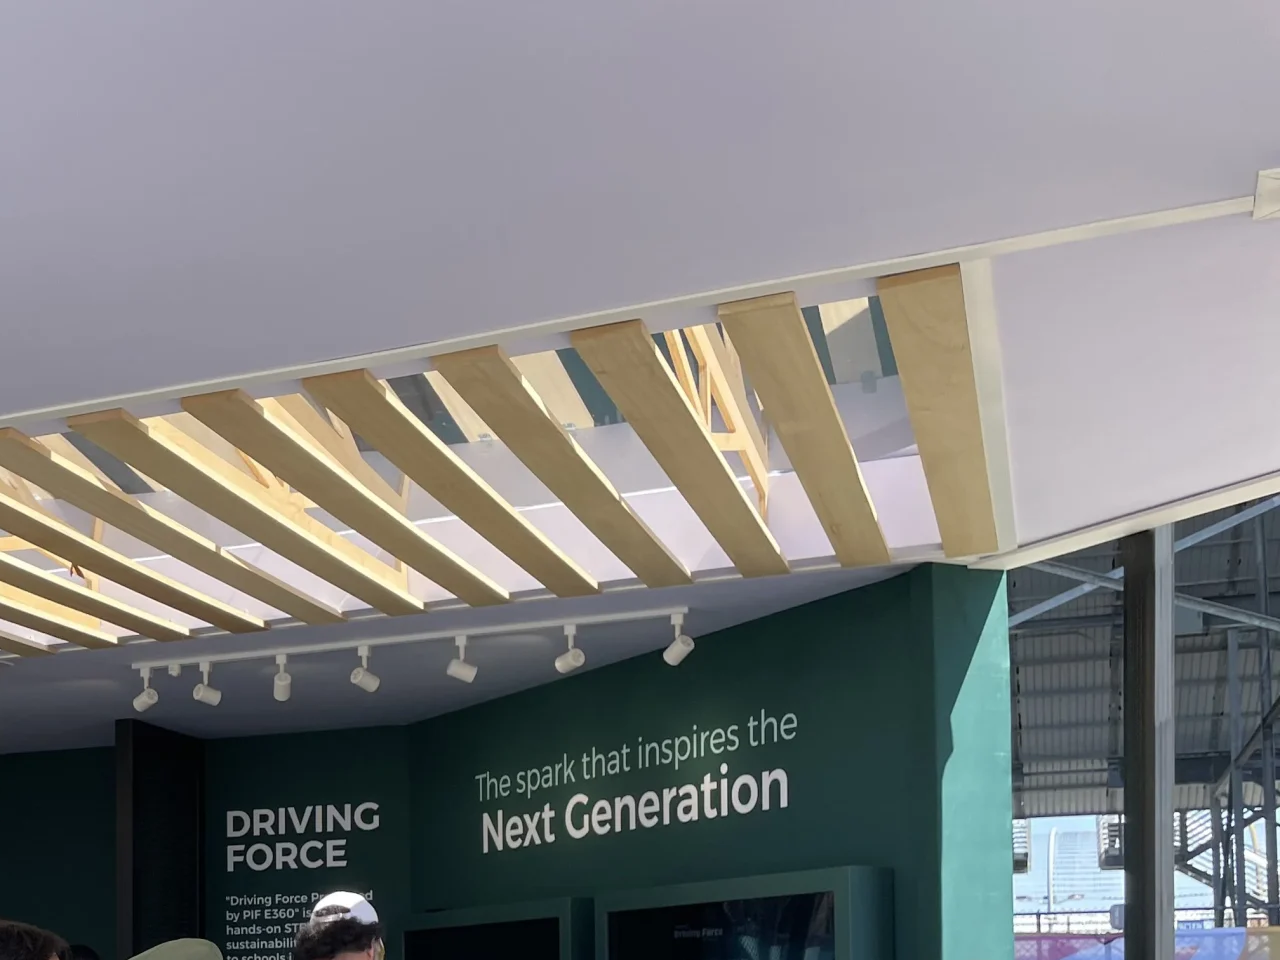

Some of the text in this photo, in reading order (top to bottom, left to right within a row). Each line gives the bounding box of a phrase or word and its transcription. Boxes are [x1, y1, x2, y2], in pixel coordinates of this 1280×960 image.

[474, 708, 798, 802] The spark that inspires the
[226, 801, 380, 838] DRIVING
[482, 762, 789, 854] Next Generation
[226, 838, 348, 873] FORCE
[225, 894, 272, 907] "Driving
[275, 893, 309, 905] Force
[226, 910, 240, 923] by
[243, 908, 262, 920] PIF
[264, 908, 300, 919] E360"
[226, 925, 281, 936] hands-on
